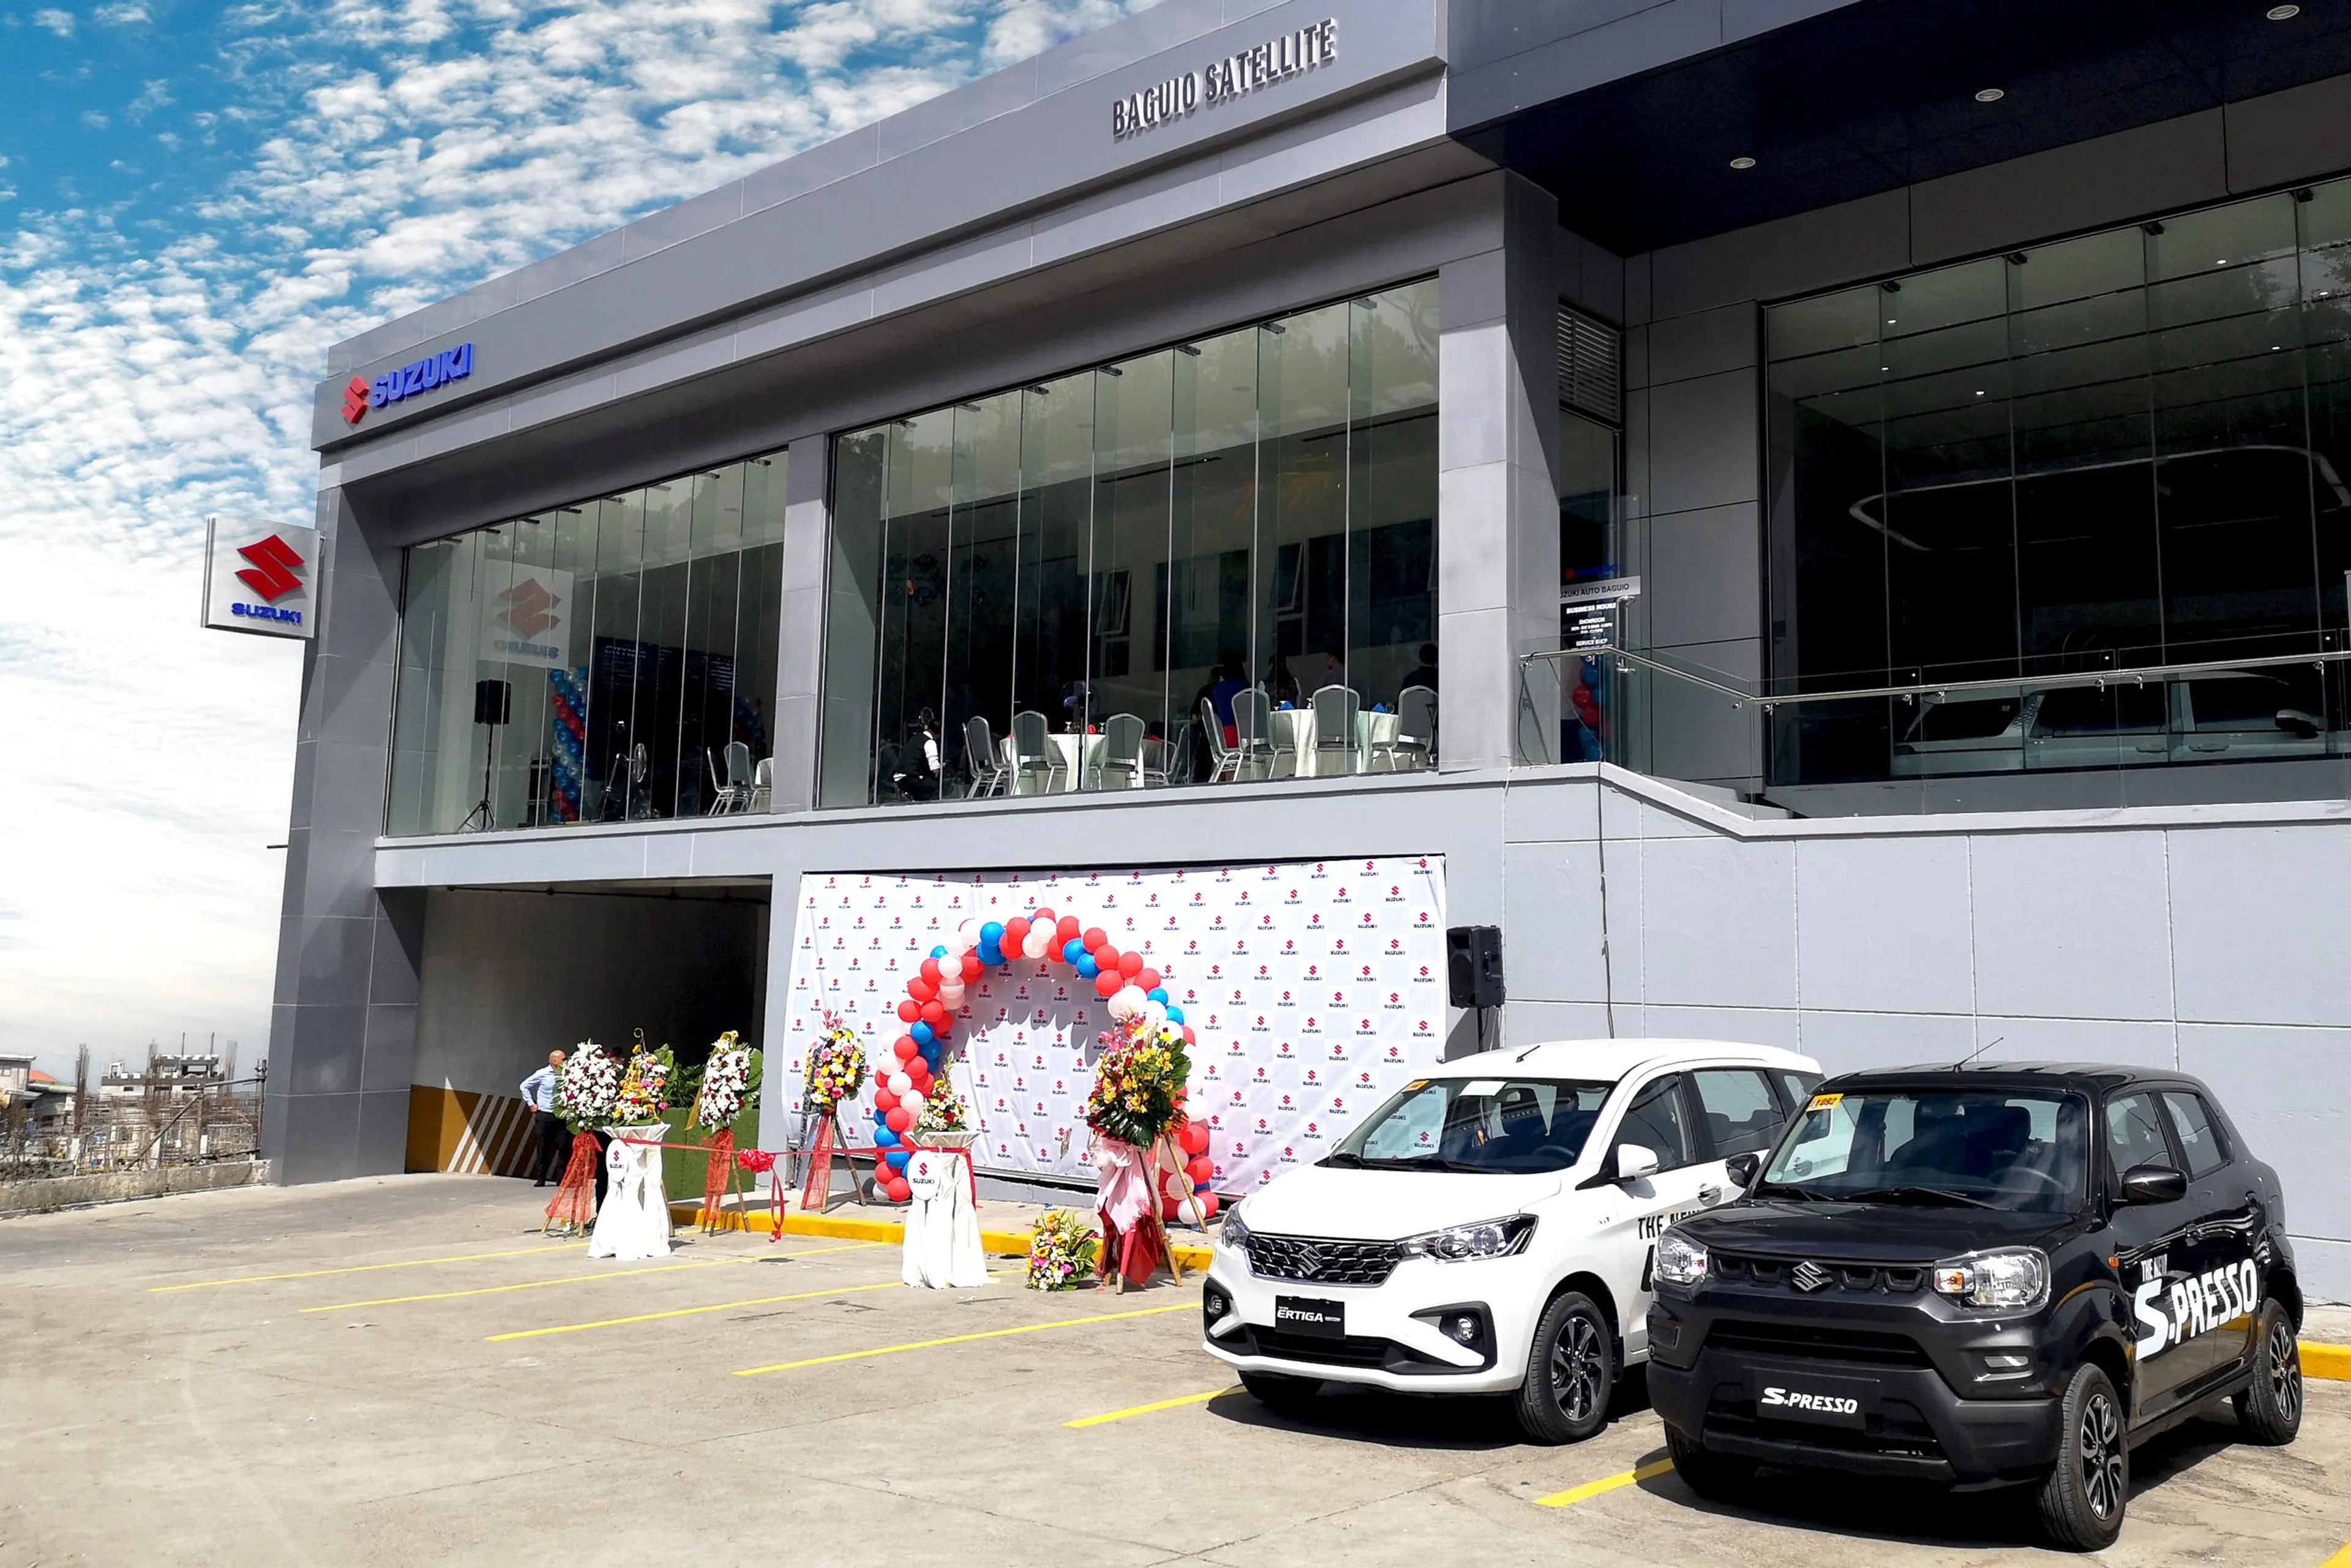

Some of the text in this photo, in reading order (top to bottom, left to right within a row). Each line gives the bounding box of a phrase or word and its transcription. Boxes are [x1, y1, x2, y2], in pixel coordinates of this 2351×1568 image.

[1112, 17, 1338, 137] BAGUIO SATELLITE
[371, 342, 473, 408] SUZUKI
[1602, 583, 1630, 593] BAGUIO
[231, 602, 302, 623] SUZUKI
[1277, 1310, 1323, 1322] ERTIGA
